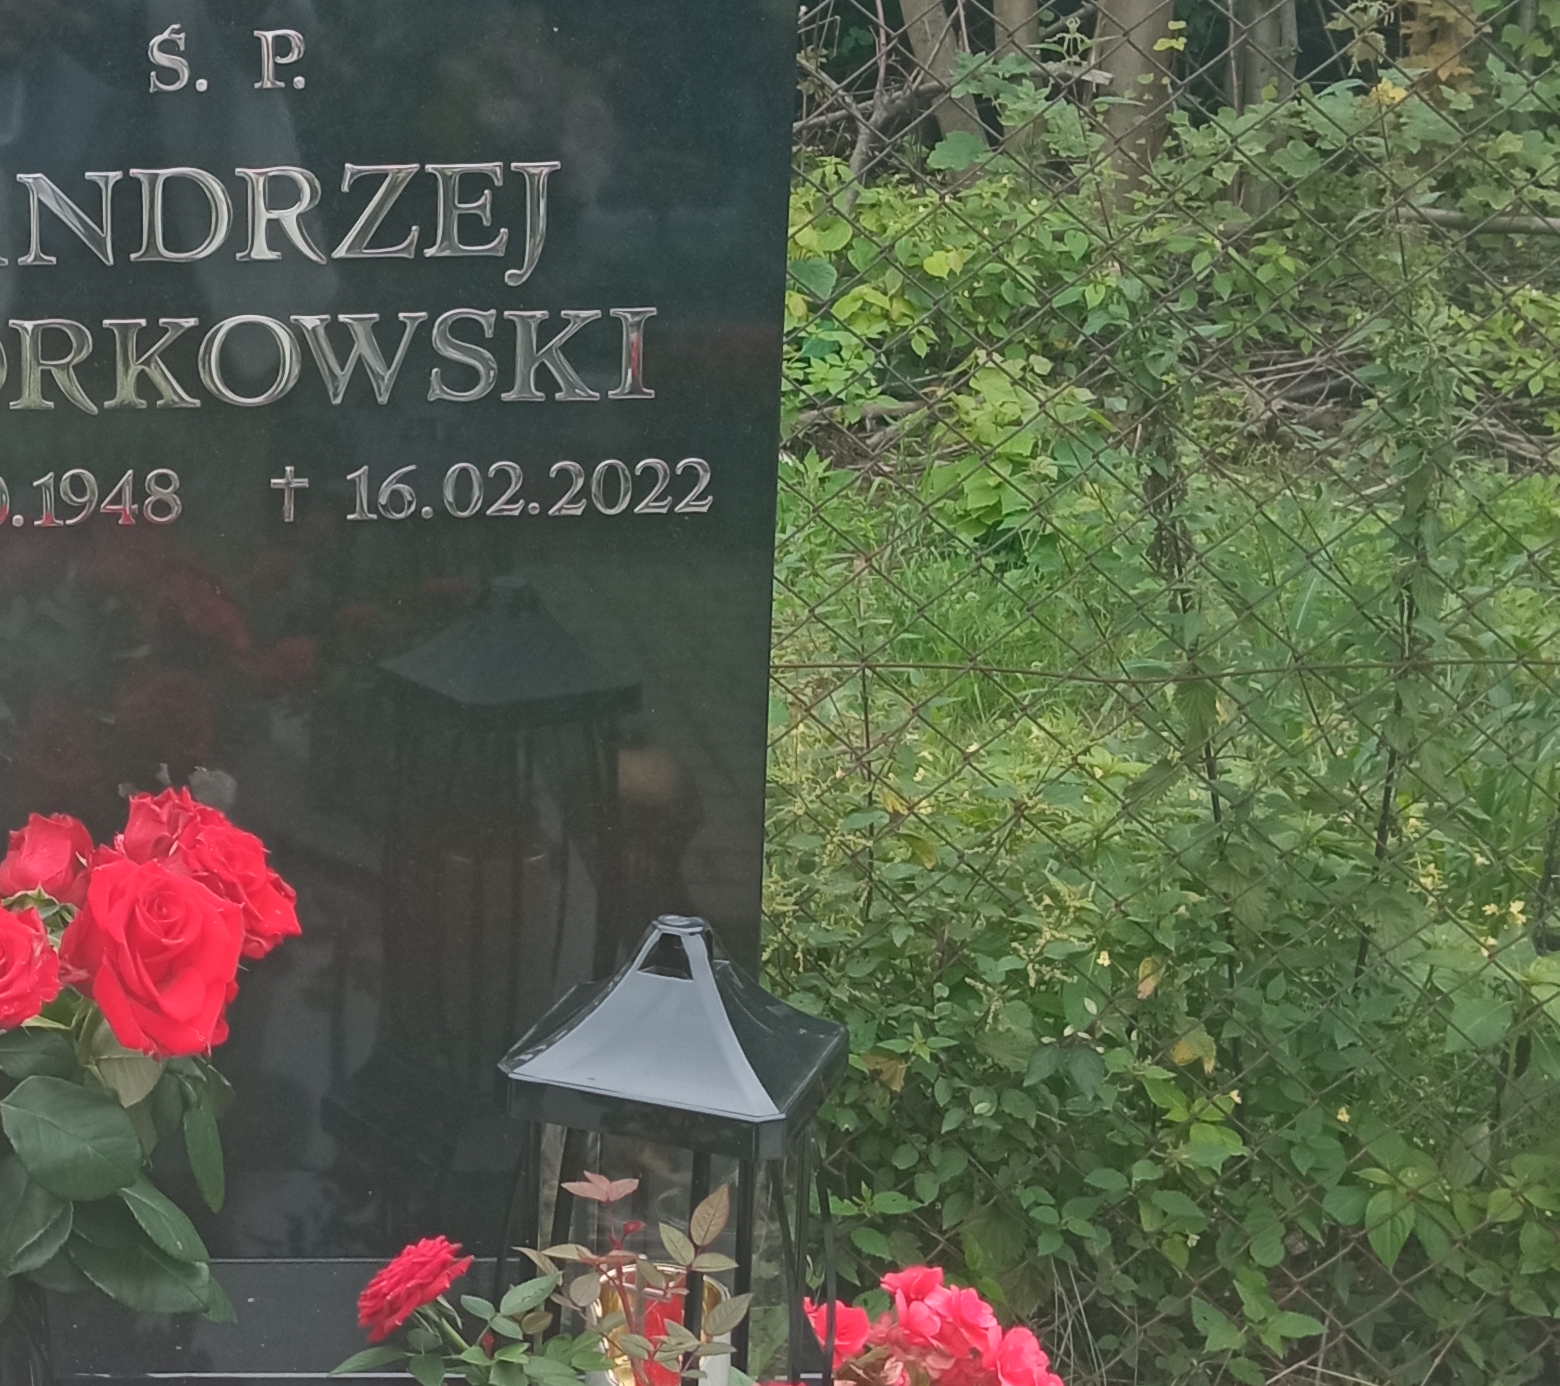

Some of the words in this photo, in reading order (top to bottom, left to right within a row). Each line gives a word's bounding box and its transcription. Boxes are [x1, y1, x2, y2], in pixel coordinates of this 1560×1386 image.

[147, 23, 208, 93] Ś.
[253, 28, 307, 91] P.
[345, 456, 714, 522] 16.02.2022
